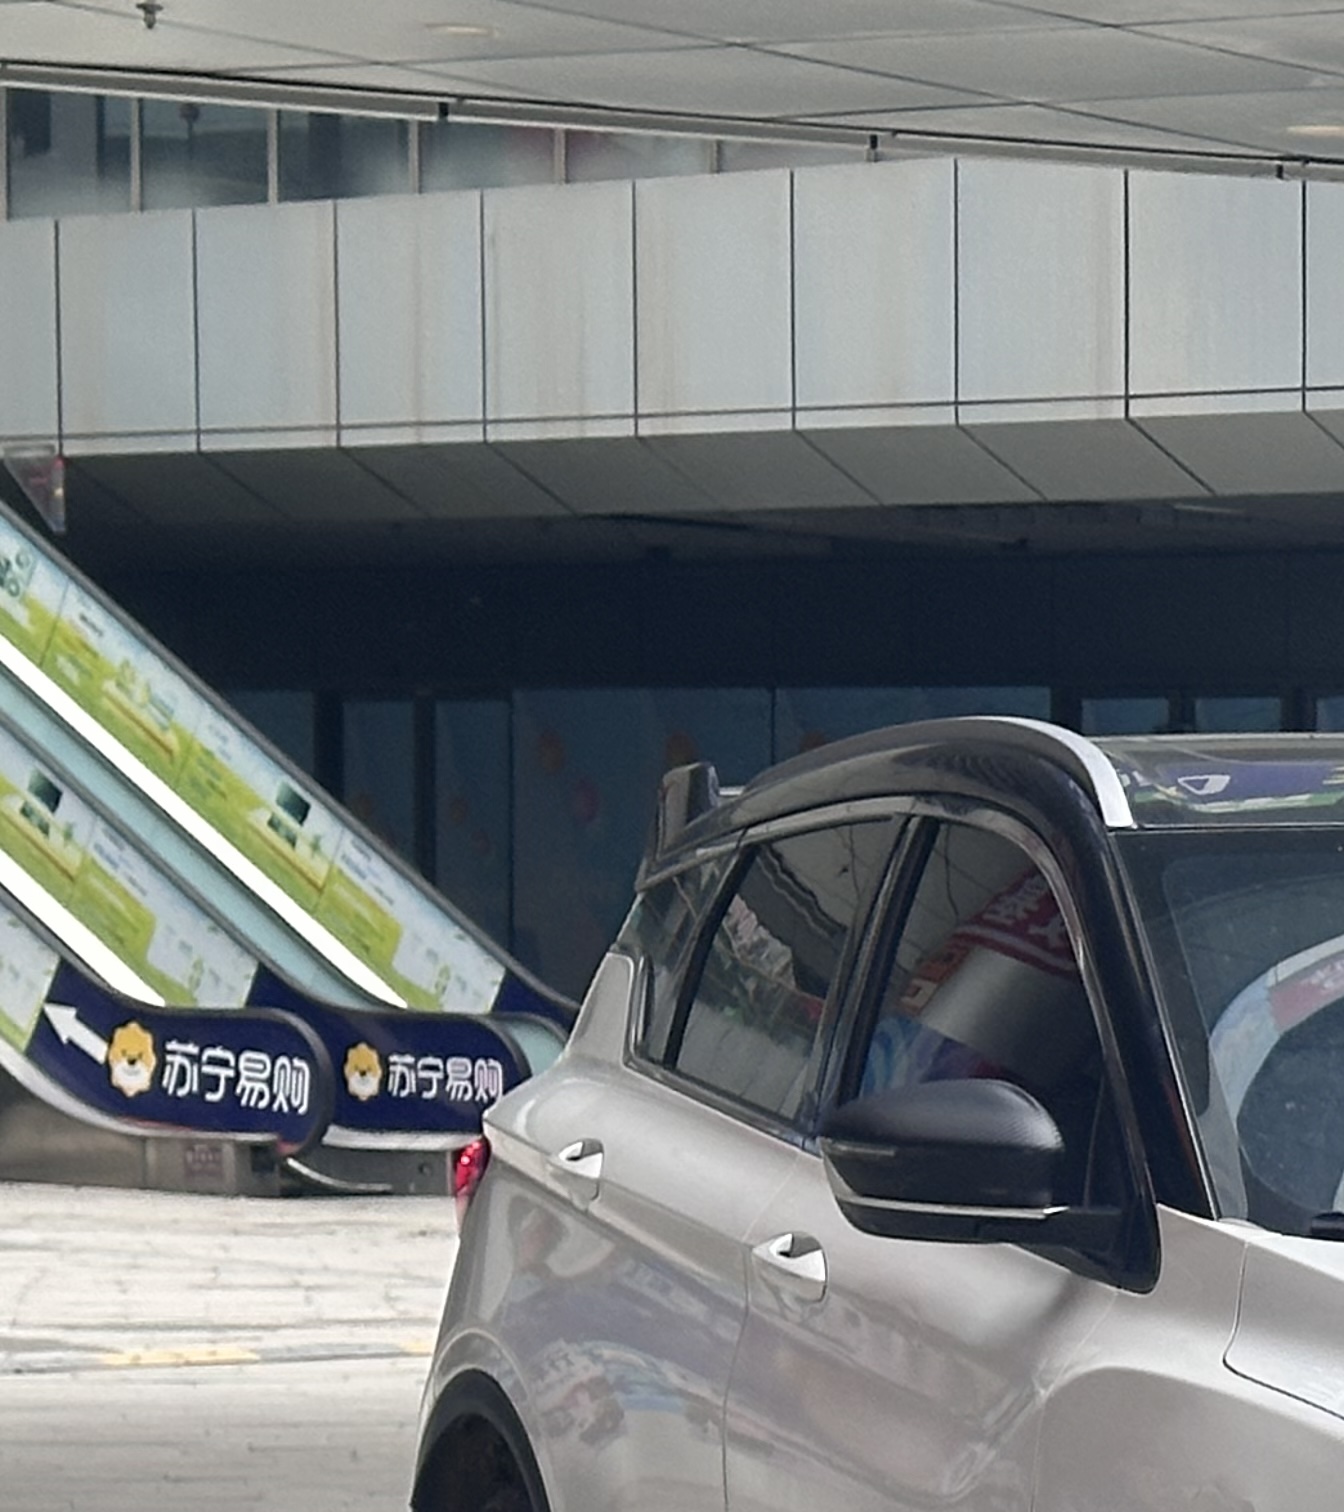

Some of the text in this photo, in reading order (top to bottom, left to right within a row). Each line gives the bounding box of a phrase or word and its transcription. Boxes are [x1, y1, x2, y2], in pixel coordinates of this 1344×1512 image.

[162, 1039, 311, 1115] 苏宁易购
[387, 1054, 503, 1103] 苏宁易购
